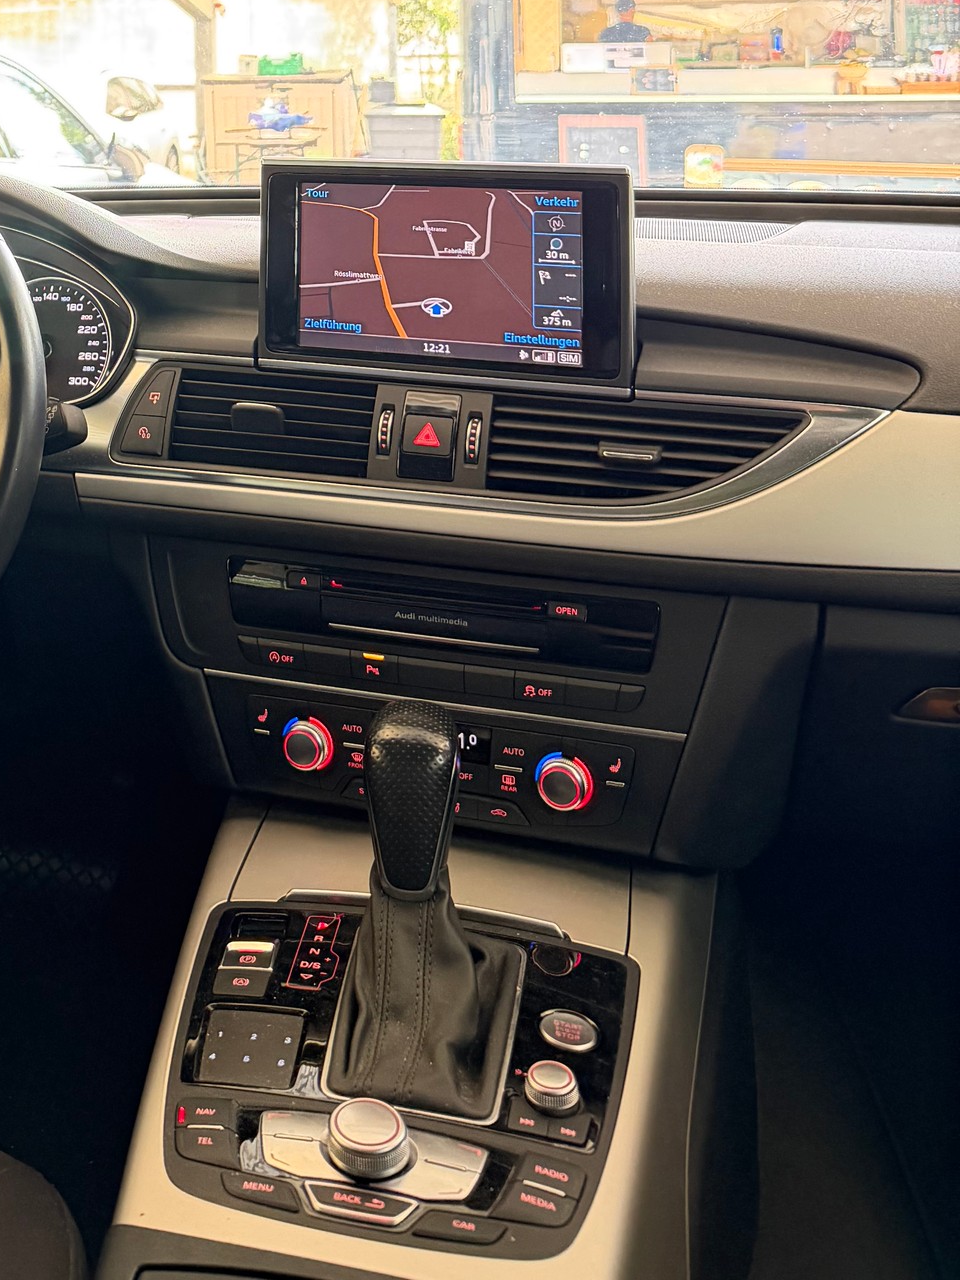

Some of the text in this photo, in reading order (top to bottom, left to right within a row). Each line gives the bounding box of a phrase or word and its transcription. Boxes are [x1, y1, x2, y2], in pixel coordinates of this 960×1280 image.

[305, 188, 330, 198] Tour
[535, 195, 580, 208] Verkehr
[545, 250, 570, 260] 30 m
[43, 293, 59, 301] 140
[66, 303, 84, 312] 180
[304, 317, 362, 334] Zielführung
[542, 316, 572, 327] 375 m
[77, 325, 98, 334] 220
[504, 331, 580, 349] Einstellungen
[423, 342, 451, 354] 12:21
[78, 352, 99, 361] 260
[560, 353, 578, 363] SIM
[68, 376, 89, 386] 300
[555, 606, 579, 616] OPEN
[394, 610, 469, 627] Audi multimedia
[281, 654, 294, 664] OFF
[537, 688, 553, 698] OFF
[341, 724, 363, 734] AUTO
[457, 731, 478, 750] 1.0
[502, 746, 525, 757] AUTO
[347, 761, 364, 770] FRON
[458, 772, 474, 781] OFF
[500, 784, 518, 793] REAR
[314, 935, 324, 943] R
[309, 947, 321, 956] N
[299, 960, 322, 970] D/S
[553, 1019, 584, 1031] START
[218, 1030, 224, 1038] 1
[249, 1033, 258, 1041] 2
[554, 1030, 581, 1041] STOP
[284, 1036, 292, 1044] 3
[208, 1052, 217, 1060] 4
[195, 1107, 216, 1116] NAV
[197, 1136, 214, 1145] TEL
[534, 1164, 570, 1184] RADIO
[242, 1180, 275, 1193] MENU
[333, 1191, 362, 1206] BACK
[520, 1191, 557, 1213] MEDIA
[452, 1219, 476, 1232] CAR
